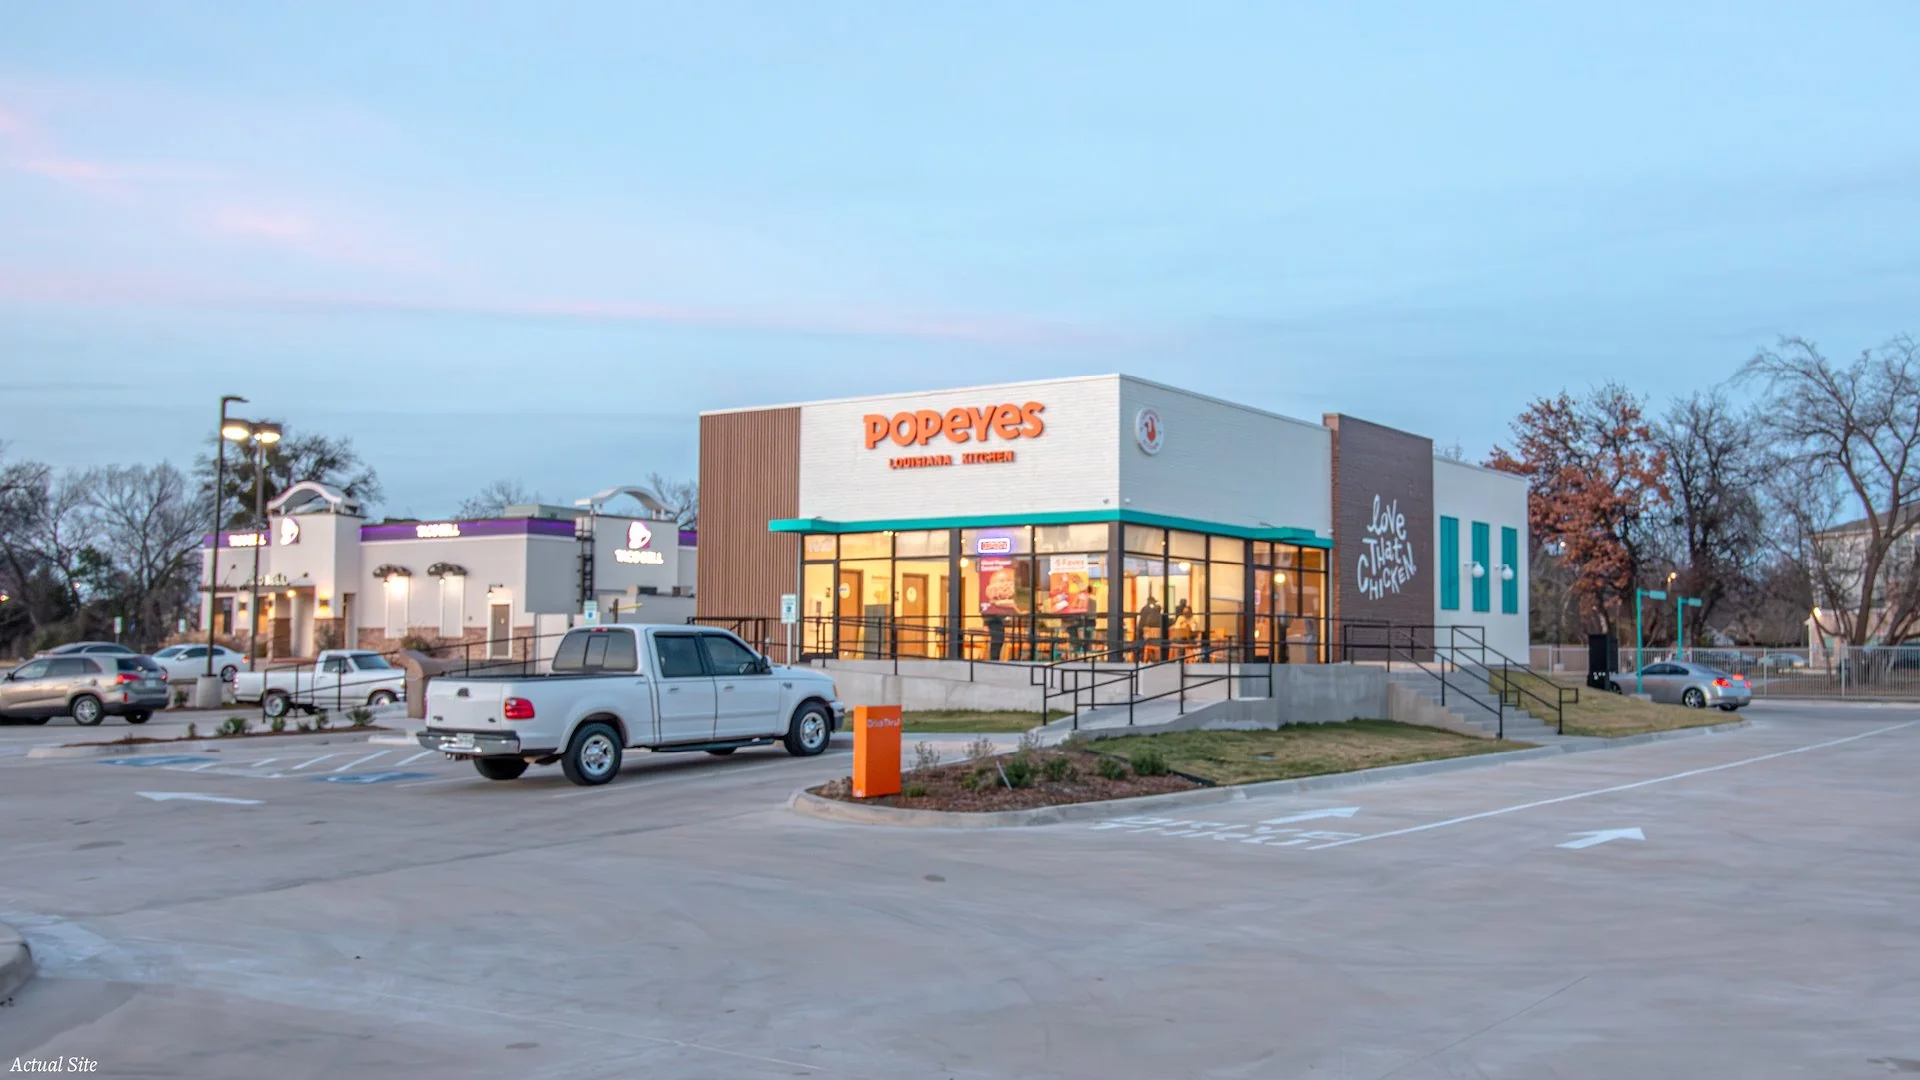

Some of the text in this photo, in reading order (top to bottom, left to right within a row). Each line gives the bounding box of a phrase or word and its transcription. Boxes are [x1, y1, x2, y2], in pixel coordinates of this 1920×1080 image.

[888, 450, 1015, 470] LOUISIANA KITCHEN
[614, 549, 664, 565] TACO BELL
